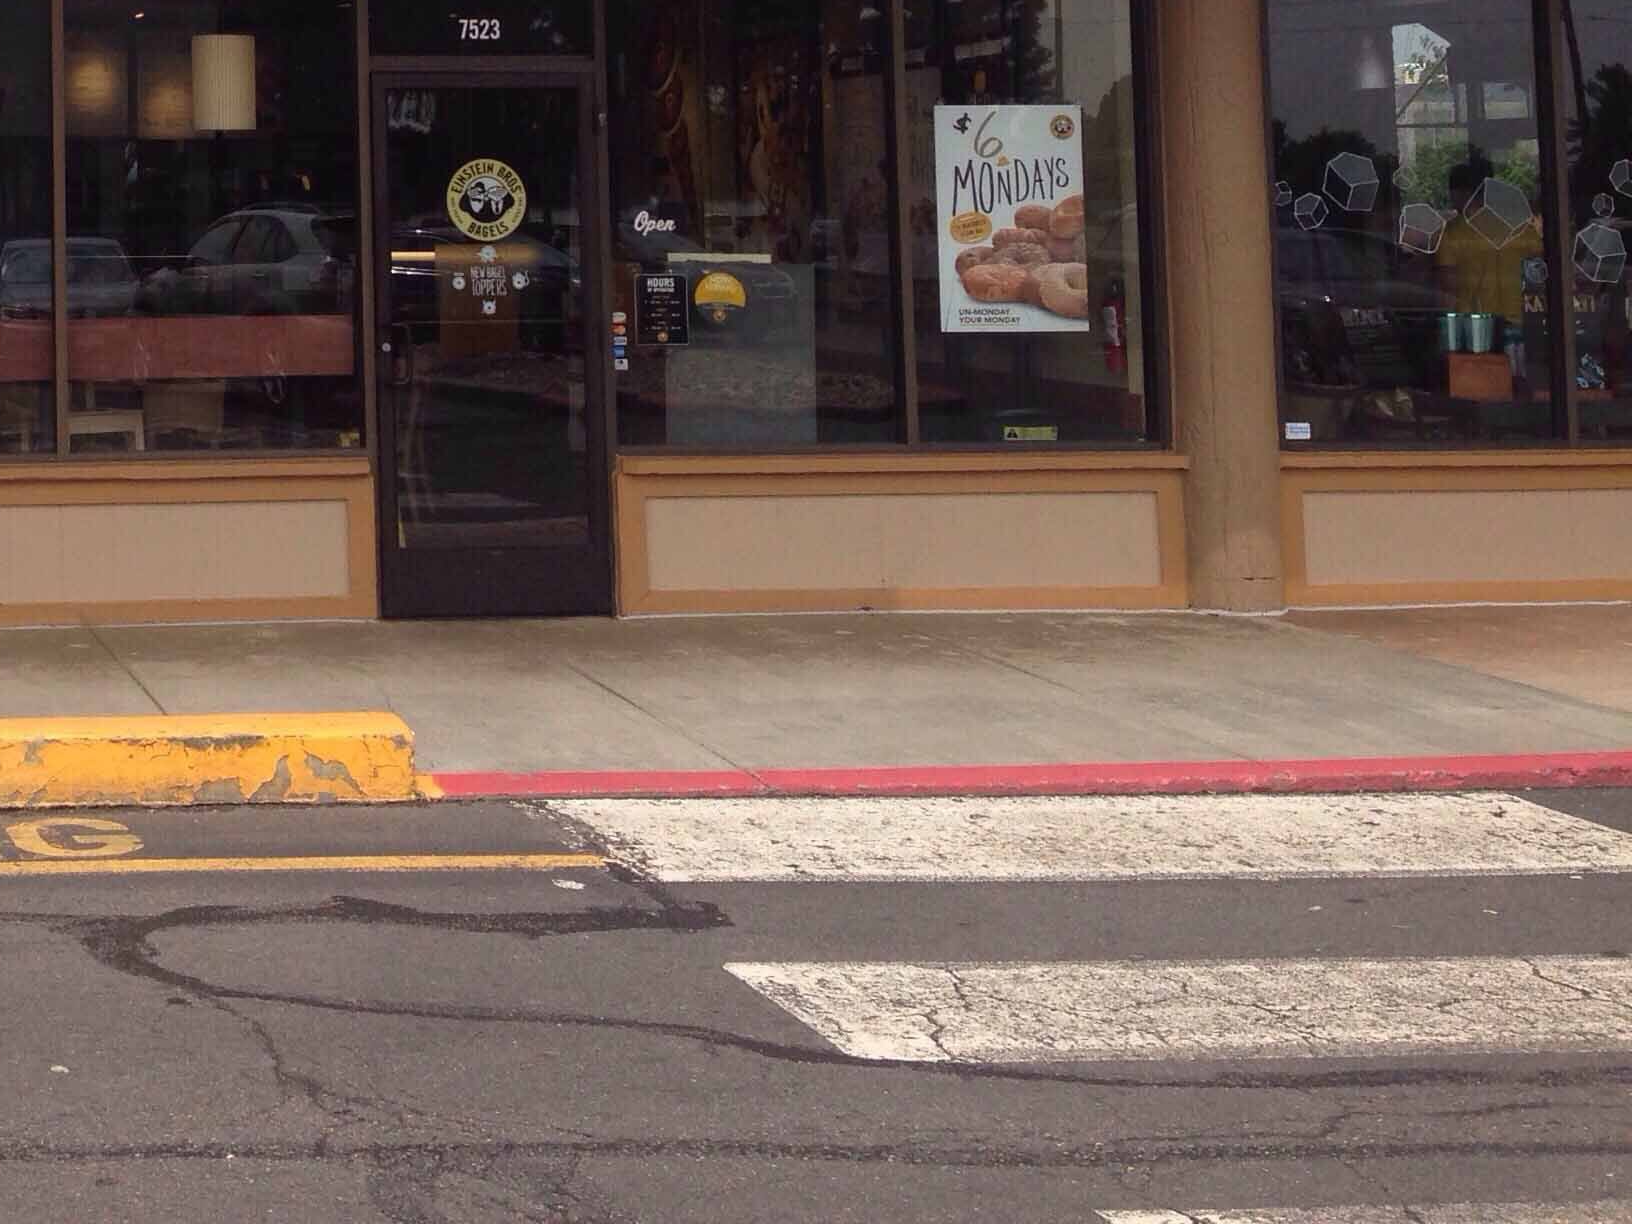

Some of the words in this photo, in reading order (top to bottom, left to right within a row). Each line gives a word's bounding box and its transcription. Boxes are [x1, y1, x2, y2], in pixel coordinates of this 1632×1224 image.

[458, 19, 501, 40] 7523
[451, 162, 495, 194] EINSTEIN
[952, 155, 1070, 215] MONDAYS
[467, 221, 509, 238] BAGELS
[633, 210, 676, 237] Open
[647, 278, 675, 287] HOURS
